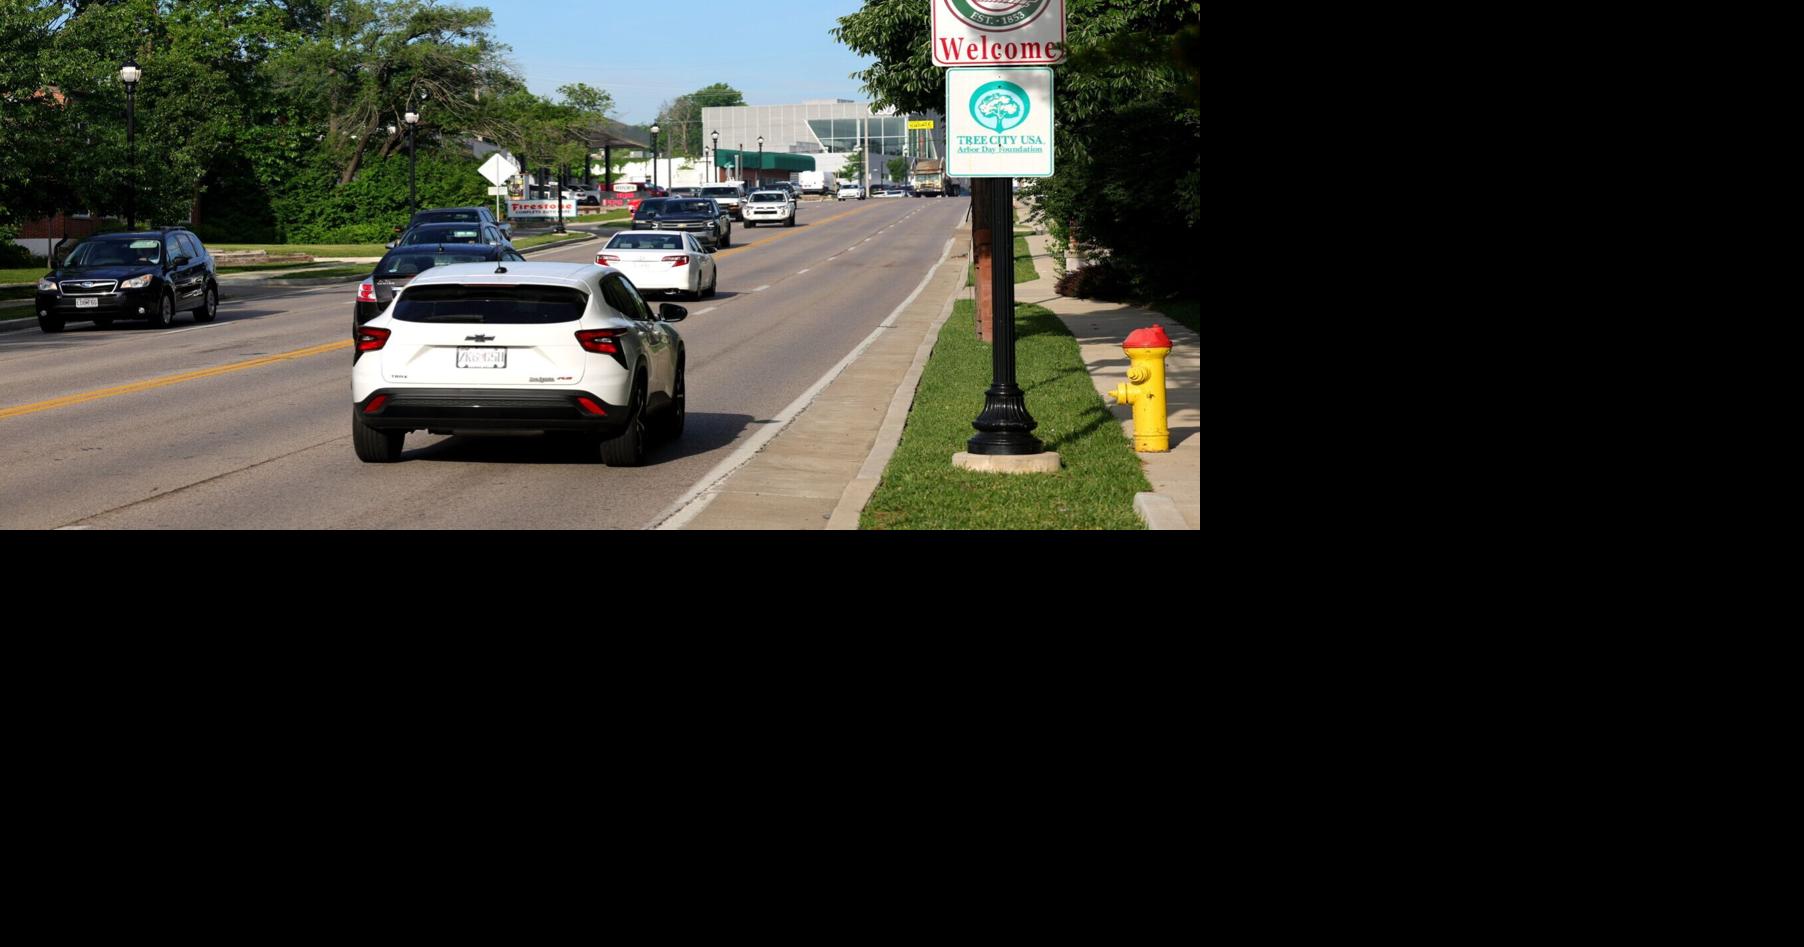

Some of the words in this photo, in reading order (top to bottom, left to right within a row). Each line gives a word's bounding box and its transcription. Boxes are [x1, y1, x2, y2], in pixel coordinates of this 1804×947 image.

[970, 11, 994, 25] EST.
[1000, 12, 1025, 24] 1853
[939, 35, 1057, 60] Welcome
[956, 135, 988, 145] TREE
[989, 135, 1017, 145] CITY
[957, 145, 979, 153] Arbor
[981, 145, 996, 154] Day
[999, 145, 1043, 153] Foundation
